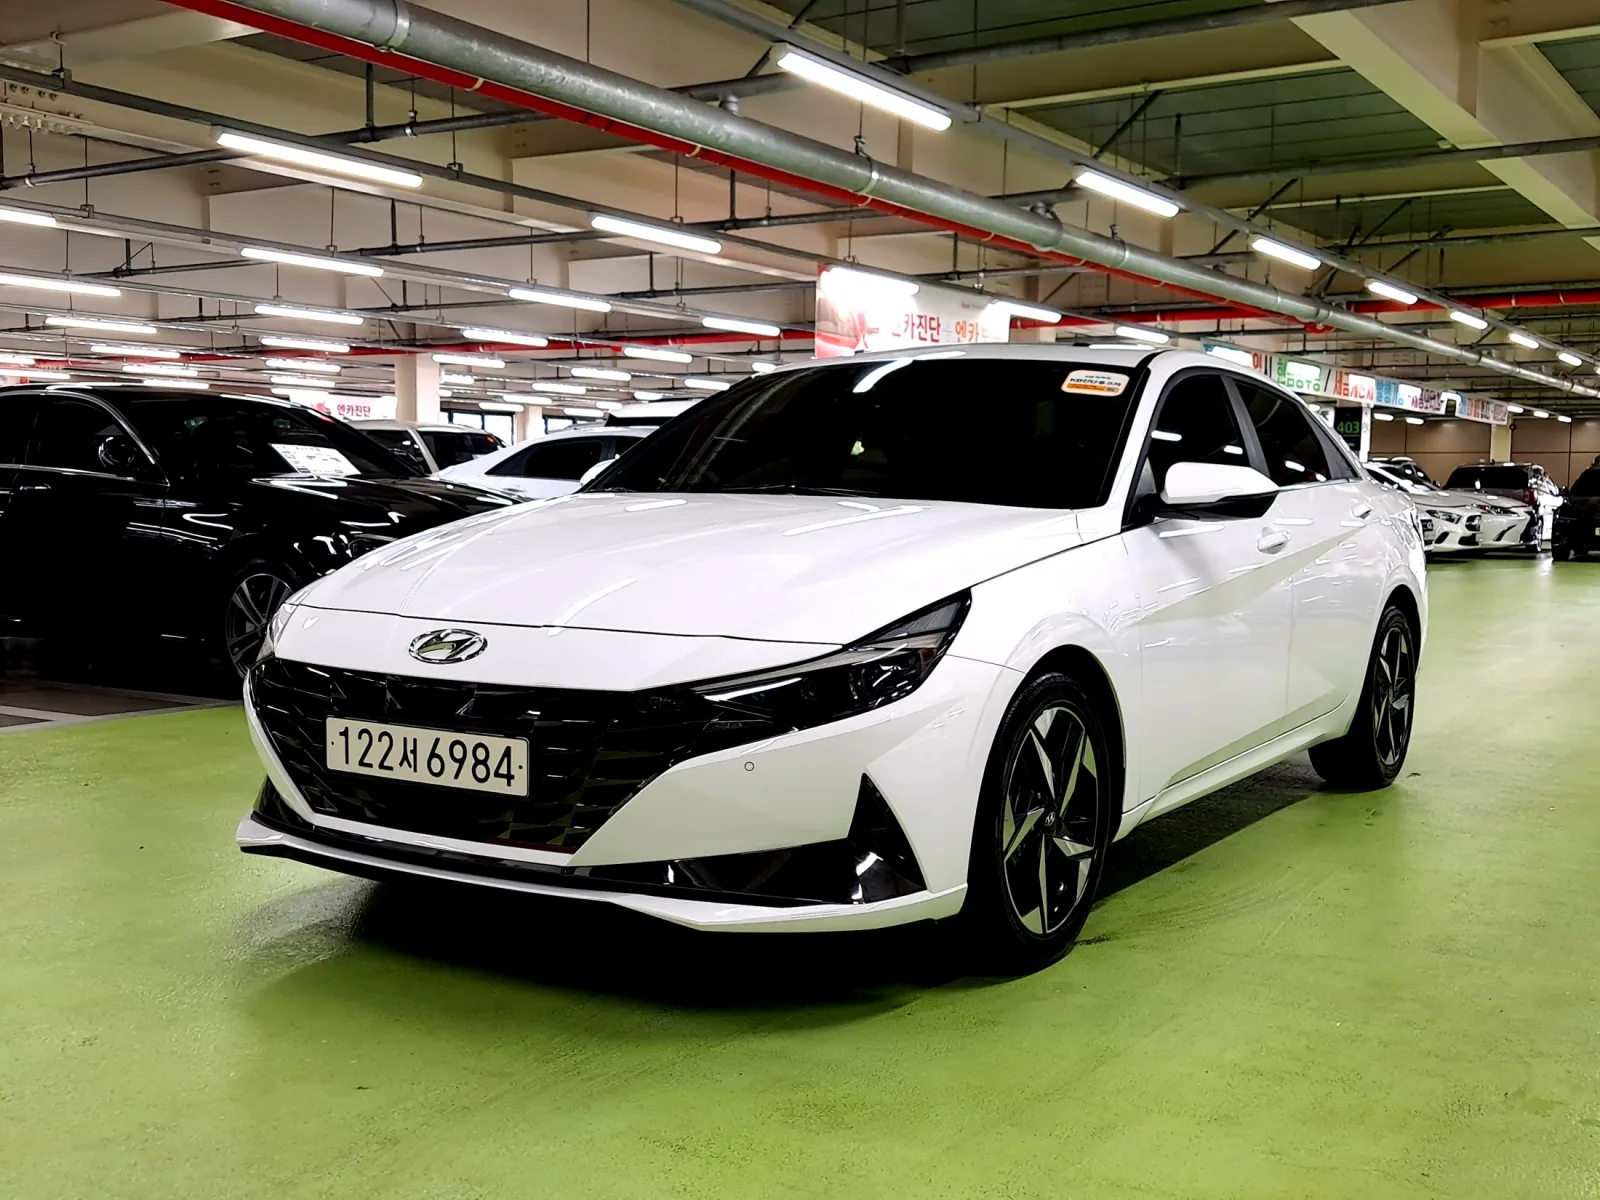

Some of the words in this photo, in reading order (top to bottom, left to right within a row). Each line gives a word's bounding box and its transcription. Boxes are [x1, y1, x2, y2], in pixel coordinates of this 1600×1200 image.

[892, 313, 942, 343] 카진단
[336, 404, 371, 417] 엔카진단
[1336, 421, 1360, 434] 403
[338, 726, 515, 787] 122서6984
